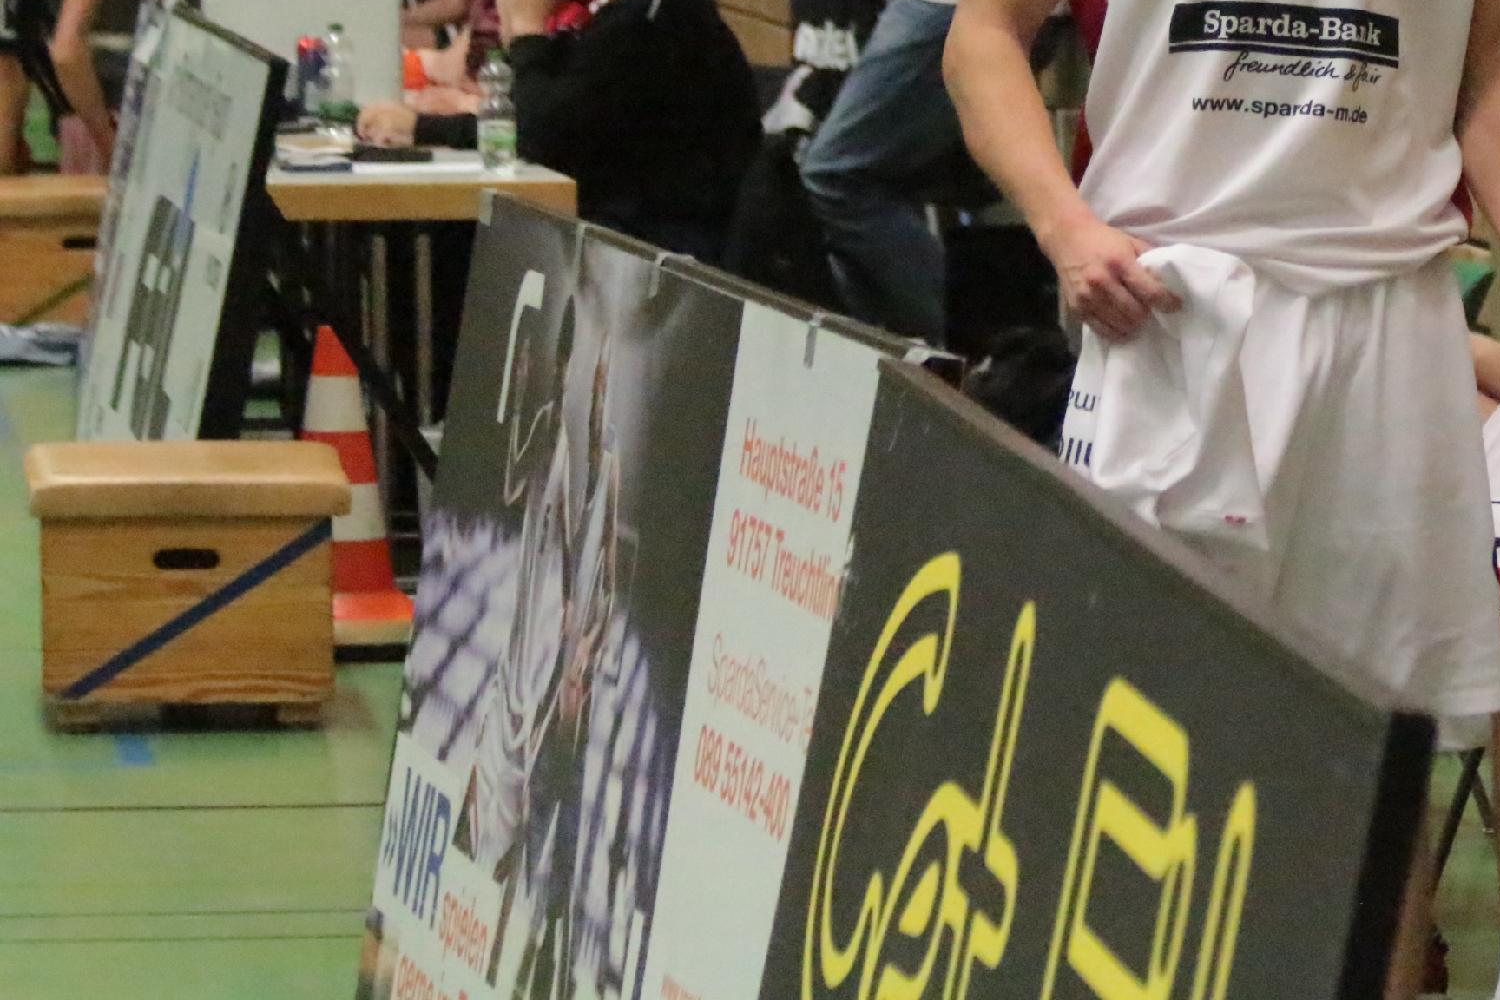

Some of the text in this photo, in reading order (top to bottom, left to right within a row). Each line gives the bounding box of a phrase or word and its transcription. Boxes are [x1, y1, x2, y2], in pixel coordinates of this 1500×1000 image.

[1191, 96, 1368, 124] www.sparda-m.de
[739, 416, 847, 523] Hauptstraße 15
[726, 508, 772, 584] 91757
[693, 723, 791, 842] 089 55142-400
